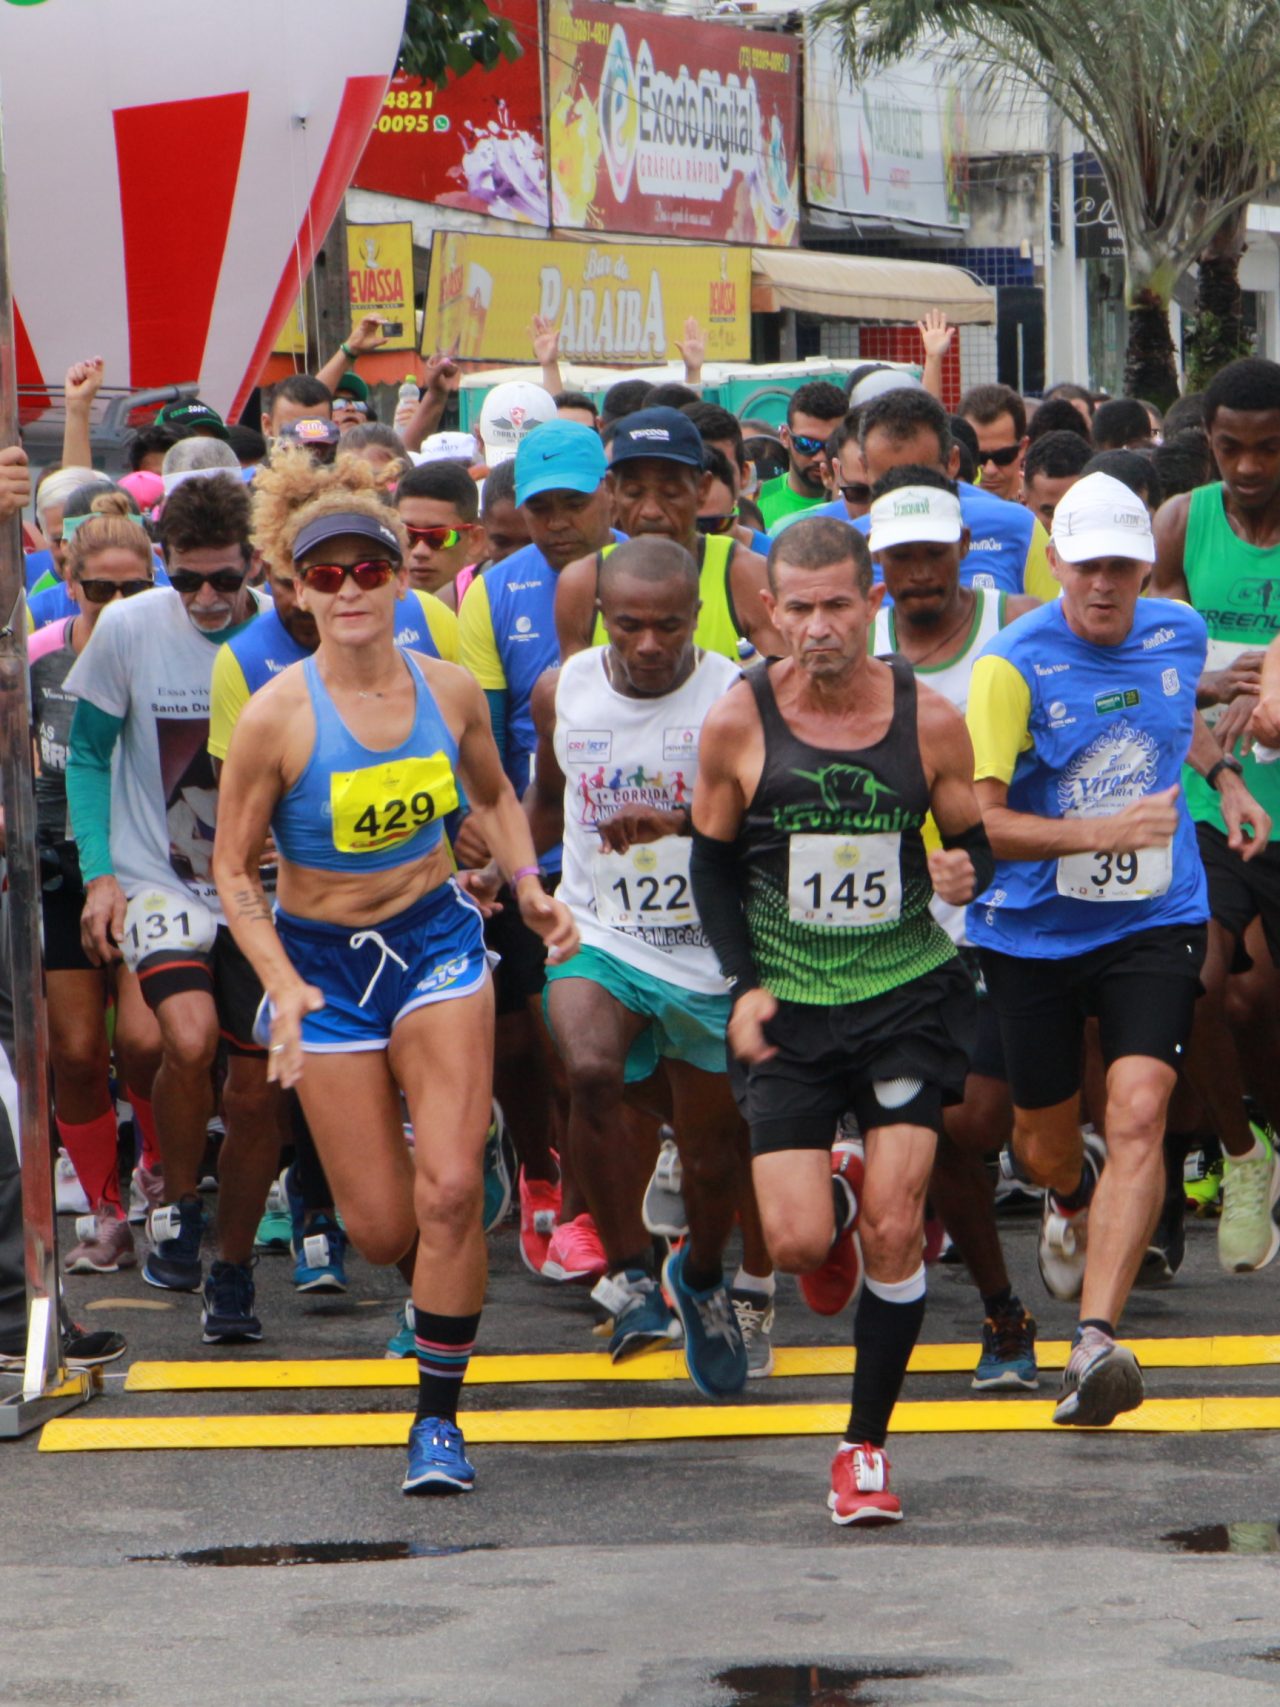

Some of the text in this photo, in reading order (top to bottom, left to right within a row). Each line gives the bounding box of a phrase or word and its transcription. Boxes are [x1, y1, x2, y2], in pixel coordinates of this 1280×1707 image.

[383, 91, 432, 108] 4821
[639, 58, 753, 172] Êxodo Digital
[583, 247, 630, 281] Bar do
[349, 268, 403, 303] EVASSA
[151, 702, 211, 713] Santa Du
[158, 686, 211, 696] Essa viv
[613, 788, 669, 802] CORRIDA
[354, 792, 435, 837] 429
[1091, 851, 1138, 886] 39
[612, 874, 690, 912] 122
[804, 870, 887, 910] 145
[126, 911, 190, 948] 131
